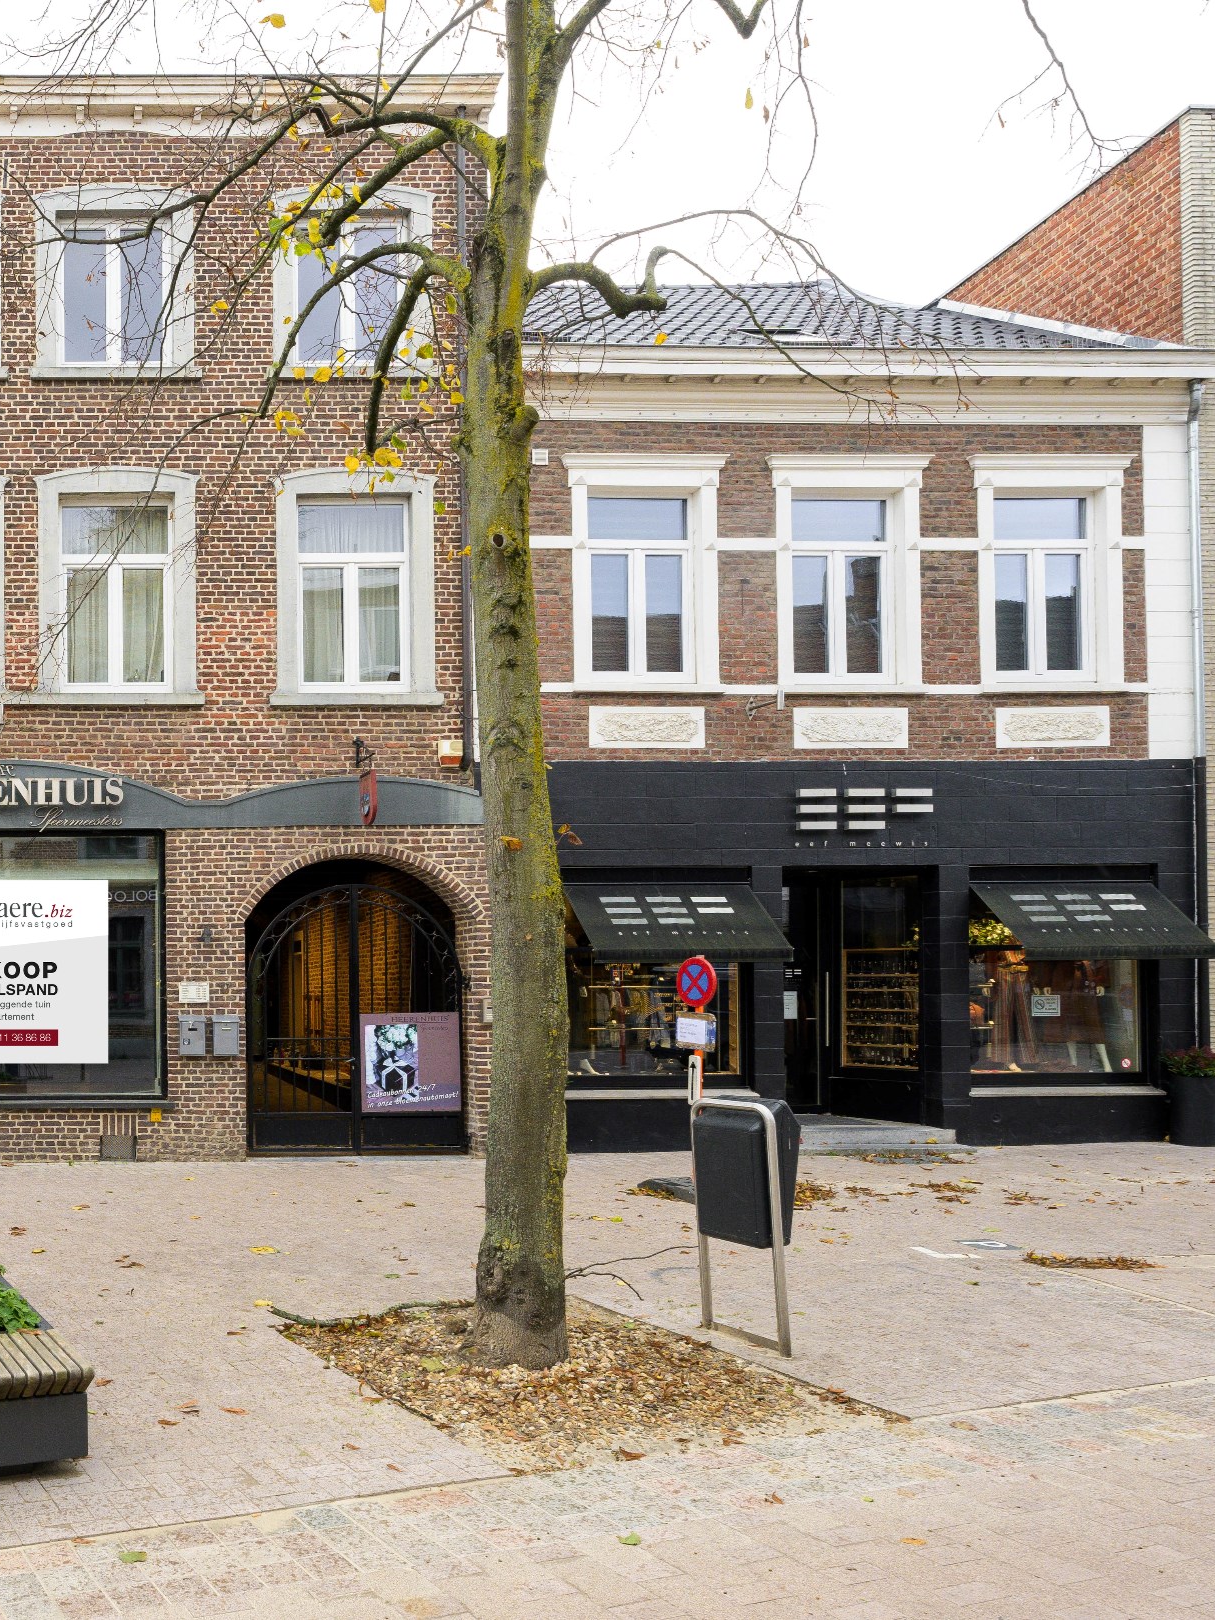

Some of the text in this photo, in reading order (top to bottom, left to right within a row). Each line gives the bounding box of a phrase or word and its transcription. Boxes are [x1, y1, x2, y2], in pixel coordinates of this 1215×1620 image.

[30, 806, 123, 832] Sfeermeesters
[11, 1033, 24, 1042] 36
[25, 1033, 38, 1042] 86
[39, 1033, 52, 1042] 86
[417, 1083, 436, 1093] 24/7
